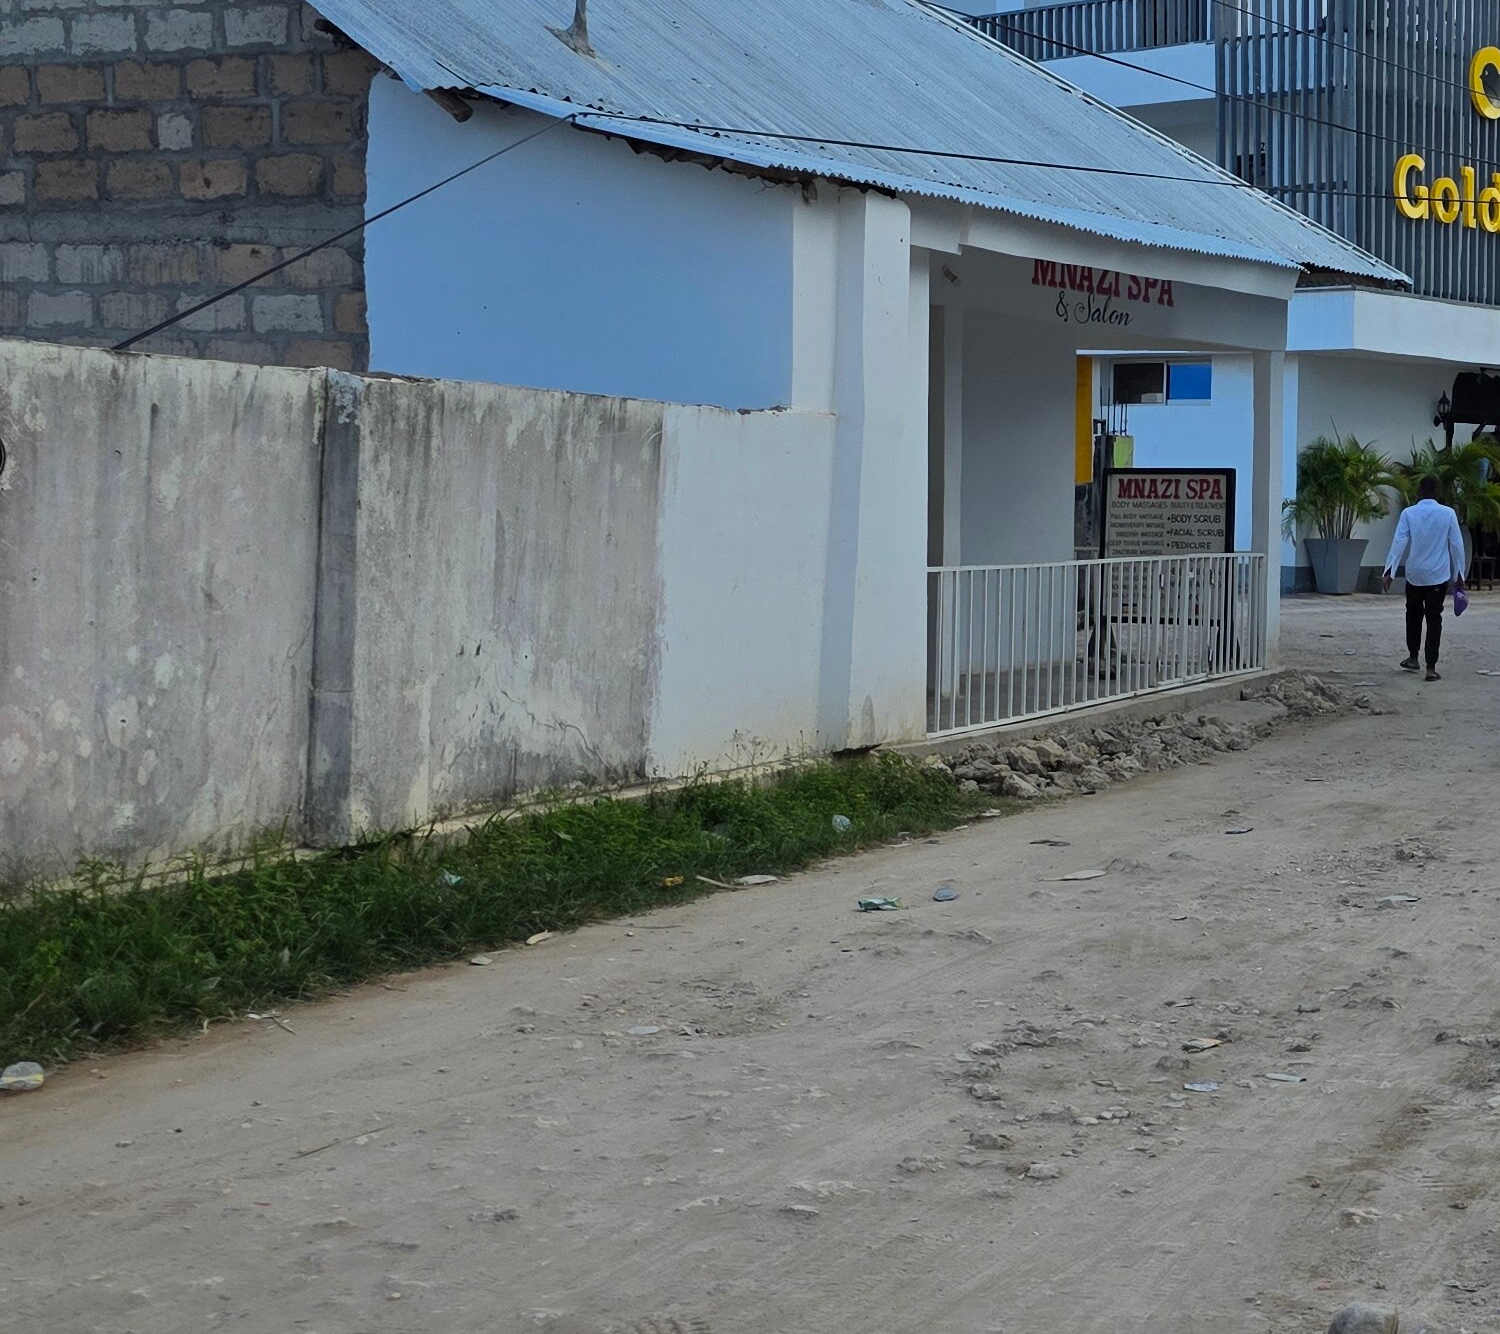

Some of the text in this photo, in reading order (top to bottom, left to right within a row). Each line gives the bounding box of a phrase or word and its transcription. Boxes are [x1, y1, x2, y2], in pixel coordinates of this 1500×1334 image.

[1032, 259, 1174, 307] MNAZI SPA
[1056, 290, 1133, 326] & Salon
[1117, 478, 1224, 500] MNAZI SPA
[1171, 514, 1221, 523] BODY SCRUB
[1197, 529, 1224, 537] SCRUB
[1171, 541, 1212, 550] PEDICURE
